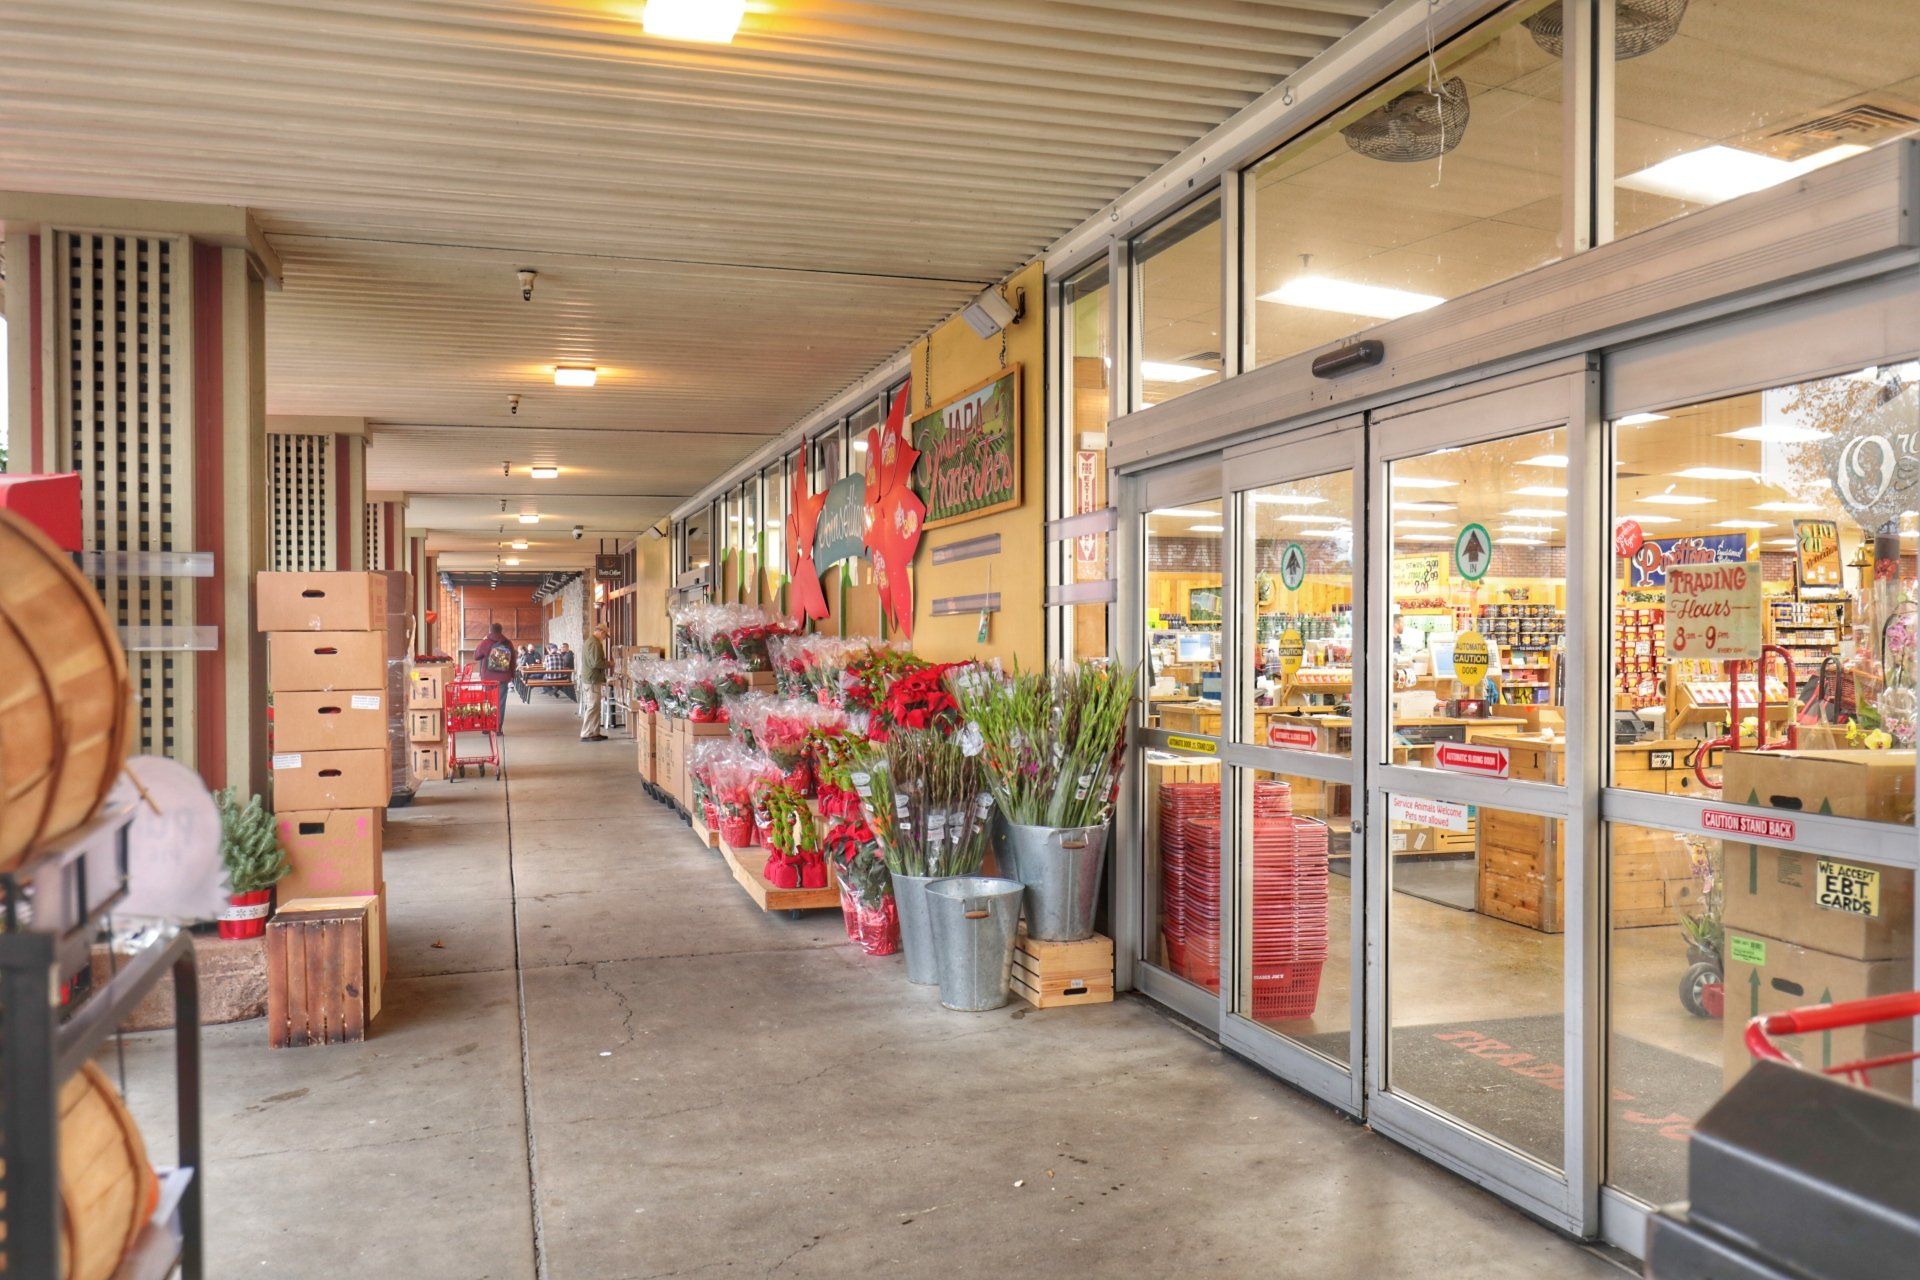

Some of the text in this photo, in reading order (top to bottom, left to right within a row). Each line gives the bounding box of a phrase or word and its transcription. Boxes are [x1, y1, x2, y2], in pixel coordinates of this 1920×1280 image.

[1469, 564, 1477, 573] IN
[1669, 566, 1746, 597] TRADING
[1671, 599, 1731, 619] Hours
[1279, 647, 1302, 656] CAUTION
[1455, 642, 1487, 651] AUTOMATIC
[1453, 654, 1488, 664] CAUTION
[1462, 666, 1477, 675] DOOR
[1446, 751, 1467, 762] AUTOMATIC
[1484, 756, 1496, 766] DOOR
[1393, 797, 1462, 817] Service Animals Welcome
[1405, 810, 1417, 822] Pets
[1428, 814, 1449, 827] allowed
[1705, 812, 1792, 838] CAUTION STAND BACK
[1818, 861, 1875, 882] WE ACCEPT
[1820, 893, 1871, 914] CARDS
